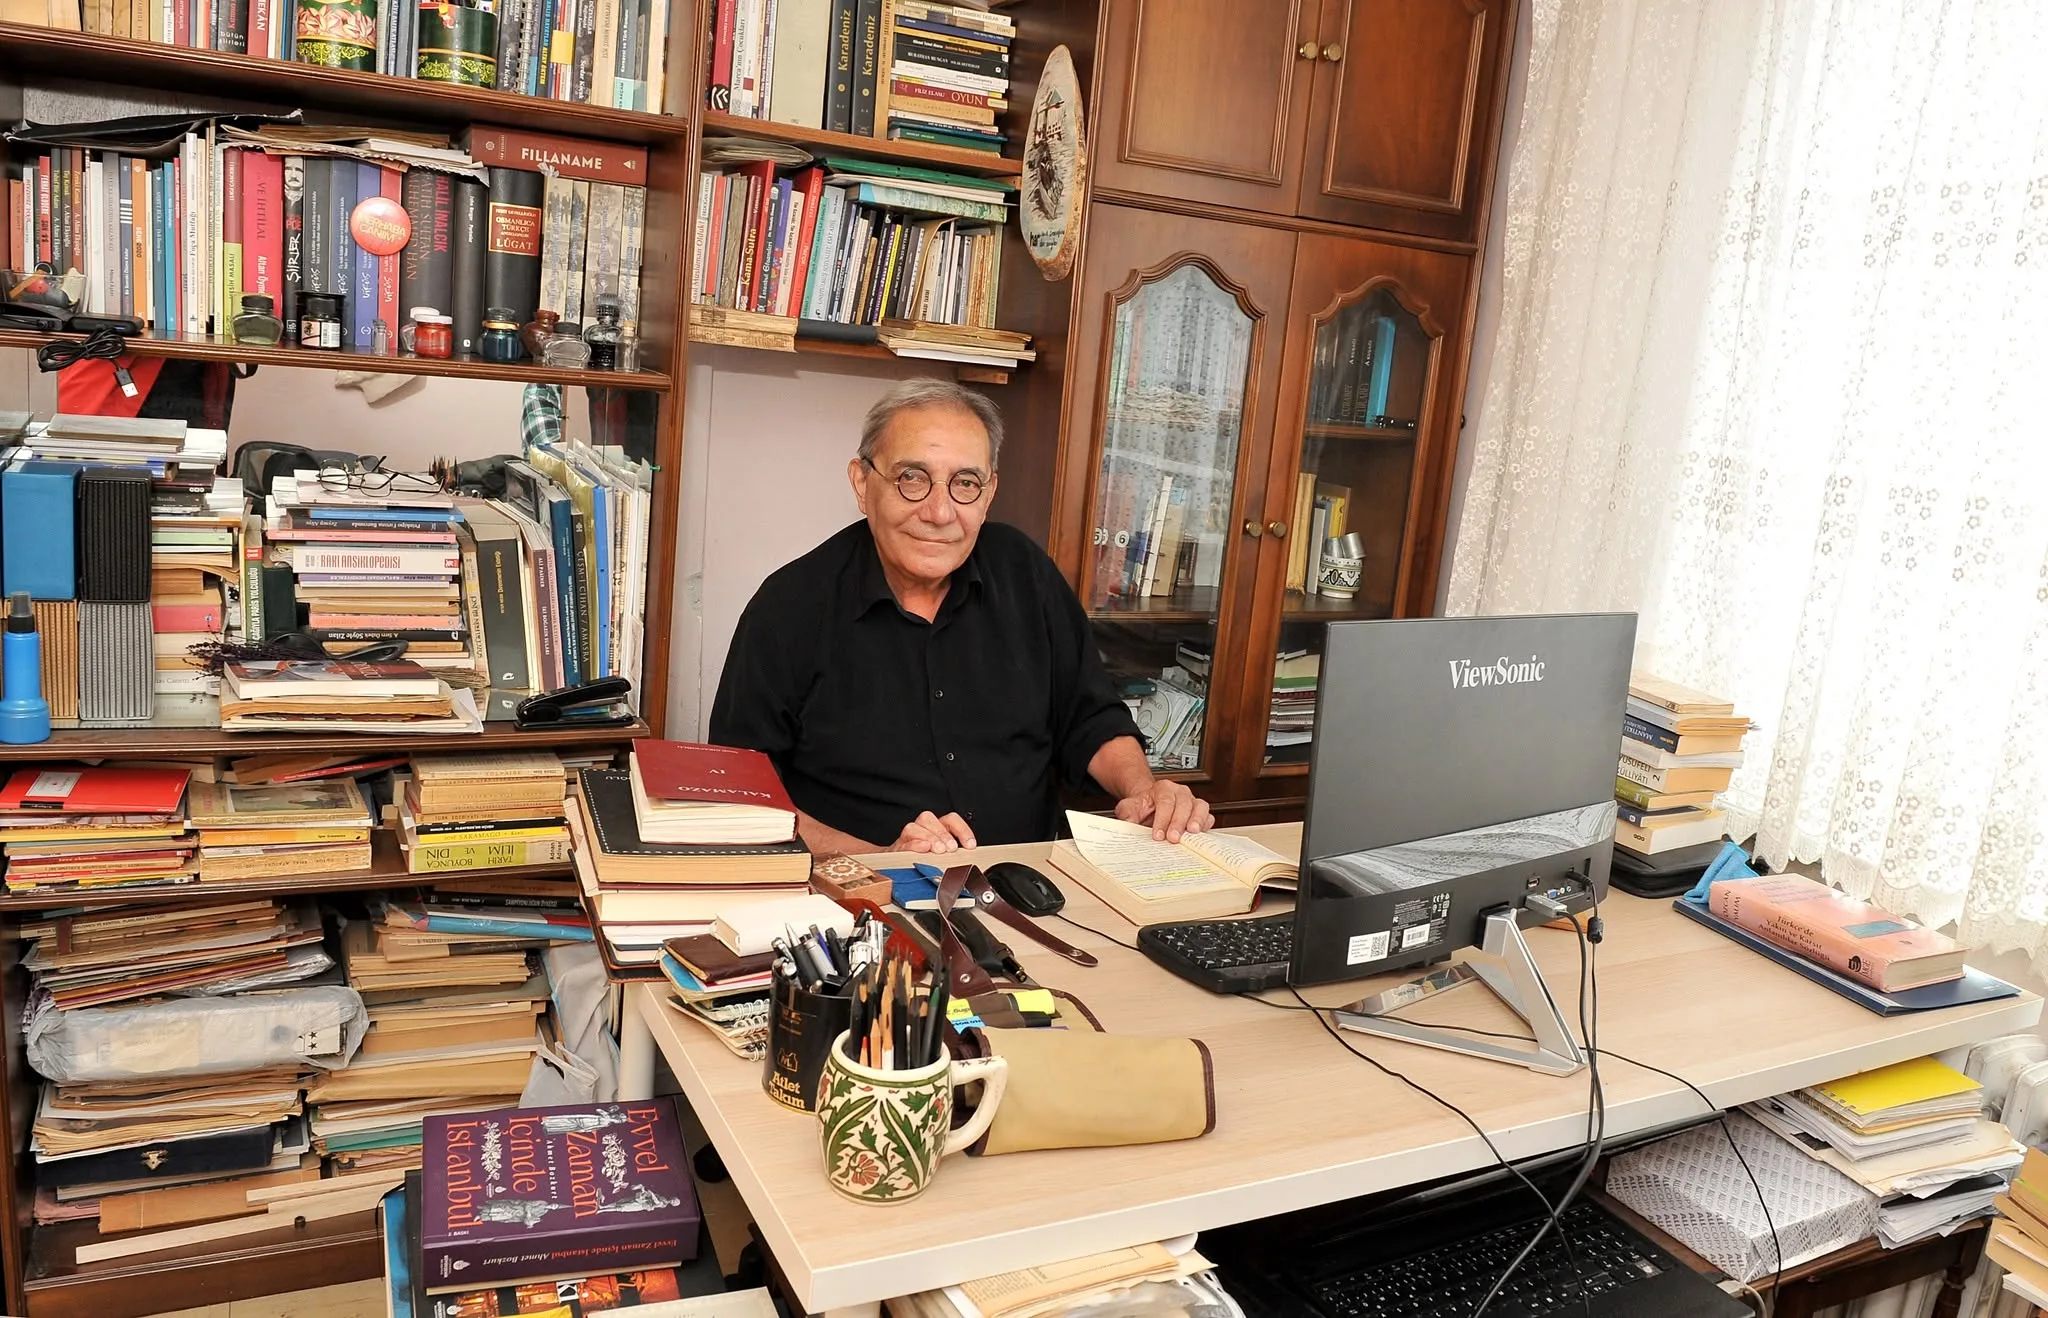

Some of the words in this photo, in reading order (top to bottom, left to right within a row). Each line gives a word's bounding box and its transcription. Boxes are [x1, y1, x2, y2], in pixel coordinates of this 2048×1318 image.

[220, 30, 244, 40] bütün
[838, 9, 851, 71] Karadeniz
[862, 15, 876, 76] Karadeniz
[951, 91, 982, 105] OYUN
[435, 176, 452, 207] HALİL
[496, 217, 535, 226] OSMANLICA
[502, 224, 529, 233] TÜRKÇE
[419, 213, 431, 260] SULTAN
[434, 210, 451, 252] İNALCIK
[189, 240, 197, 256] Foça
[745, 228, 757, 256] Sutra
[256, 256, 267, 275] Altan
[287, 233, 301, 282] ŞİİRLER
[407, 252, 417, 280] HAN
[741, 257, 754, 286] Kama
[320, 555, 340, 569] RAKI
[247, 568, 260, 599] YOLCULUĞU
[249, 600, 260, 616] PARİS
[1449, 655, 1545, 688] ViewSonic
[1620, 754, 1651, 772] YUSUFELİ
[678, 786, 771, 798] KALAMAZO
[458, 831, 501, 840] SARAMAGO
[426, 848, 450, 860] DİN
[488, 844, 514, 856] İLİM
[427, 858, 473, 869] BOYUNCA
[487, 856, 513, 865] TARİH
[1766, 919, 1787, 934] Yakın
[771, 1071, 801, 1095] Atlet
[768, 1082, 806, 1110] Takım
[627, 1106, 670, 1173] Evvel
[546, 1140, 555, 1164] Ahmet
[447, 1120, 488, 1229] İstanbul
[548, 1166, 558, 1199] Bozkurt
[566, 1130, 600, 1219] Zaman
[621, 1242, 652, 1251] Zaman
[653, 1240, 677, 1249] Evvel
[483, 1255, 518, 1266] Bozkurt
[520, 1252, 550, 1263] Ahmet
